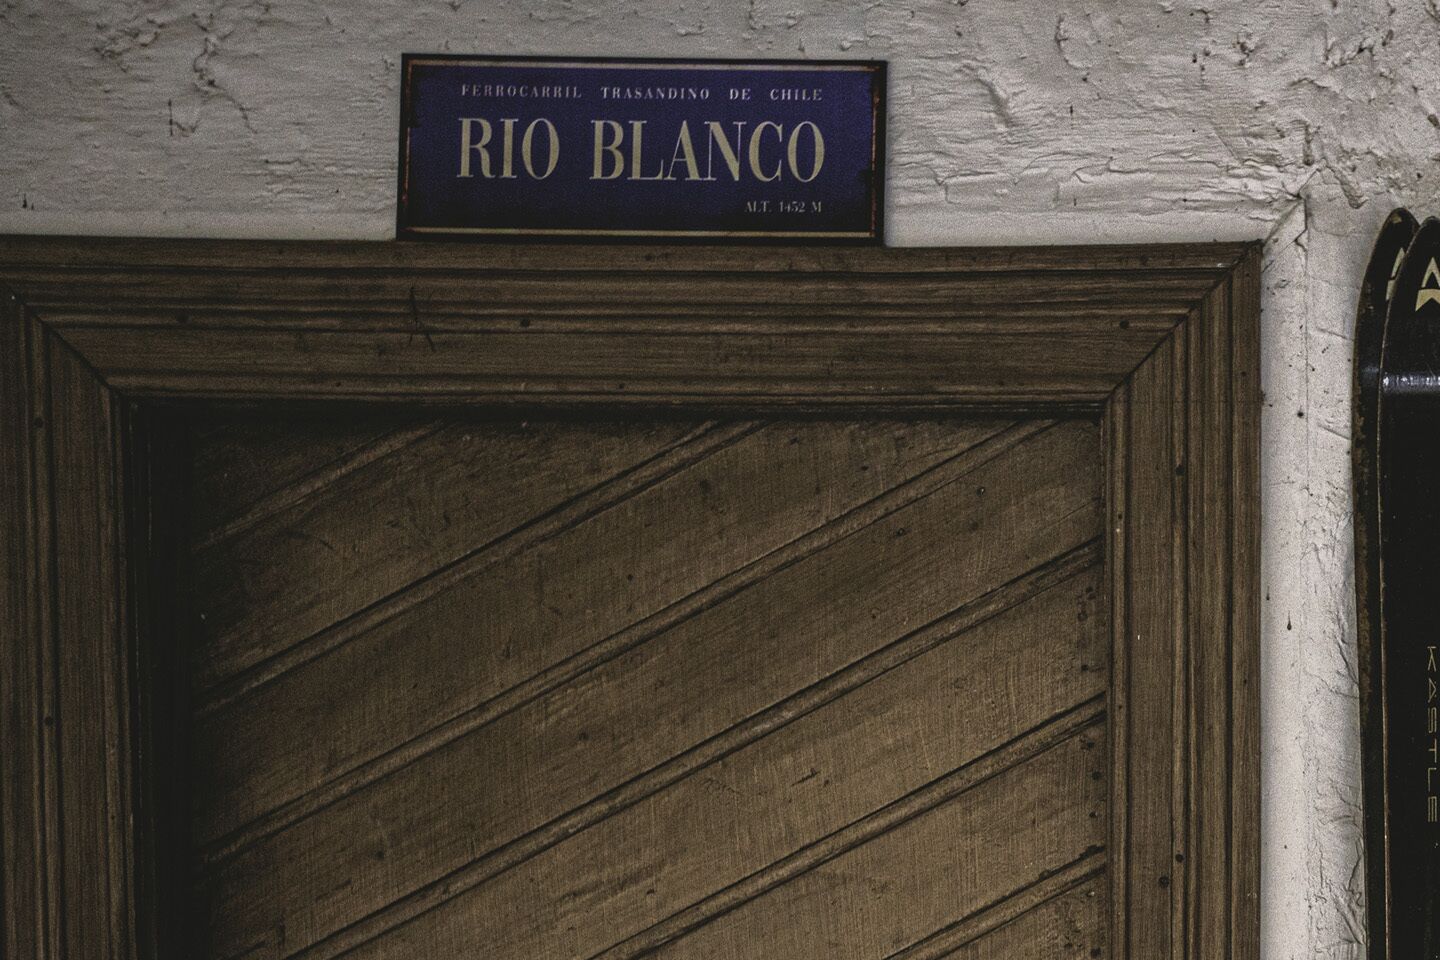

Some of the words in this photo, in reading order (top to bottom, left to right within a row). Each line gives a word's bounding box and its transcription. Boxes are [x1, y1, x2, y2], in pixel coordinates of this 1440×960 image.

[461, 84, 582, 98] FERROCARRIL
[600, 86, 710, 101] TRASANDINO
[729, 88, 752, 101] DE
[770, 88, 823, 101] CHILE
[456, 117, 560, 181] RIO
[589, 119, 825, 183] BLANCO
[779, 201, 806, 213] 1452
[811, 202, 823, 213] M
